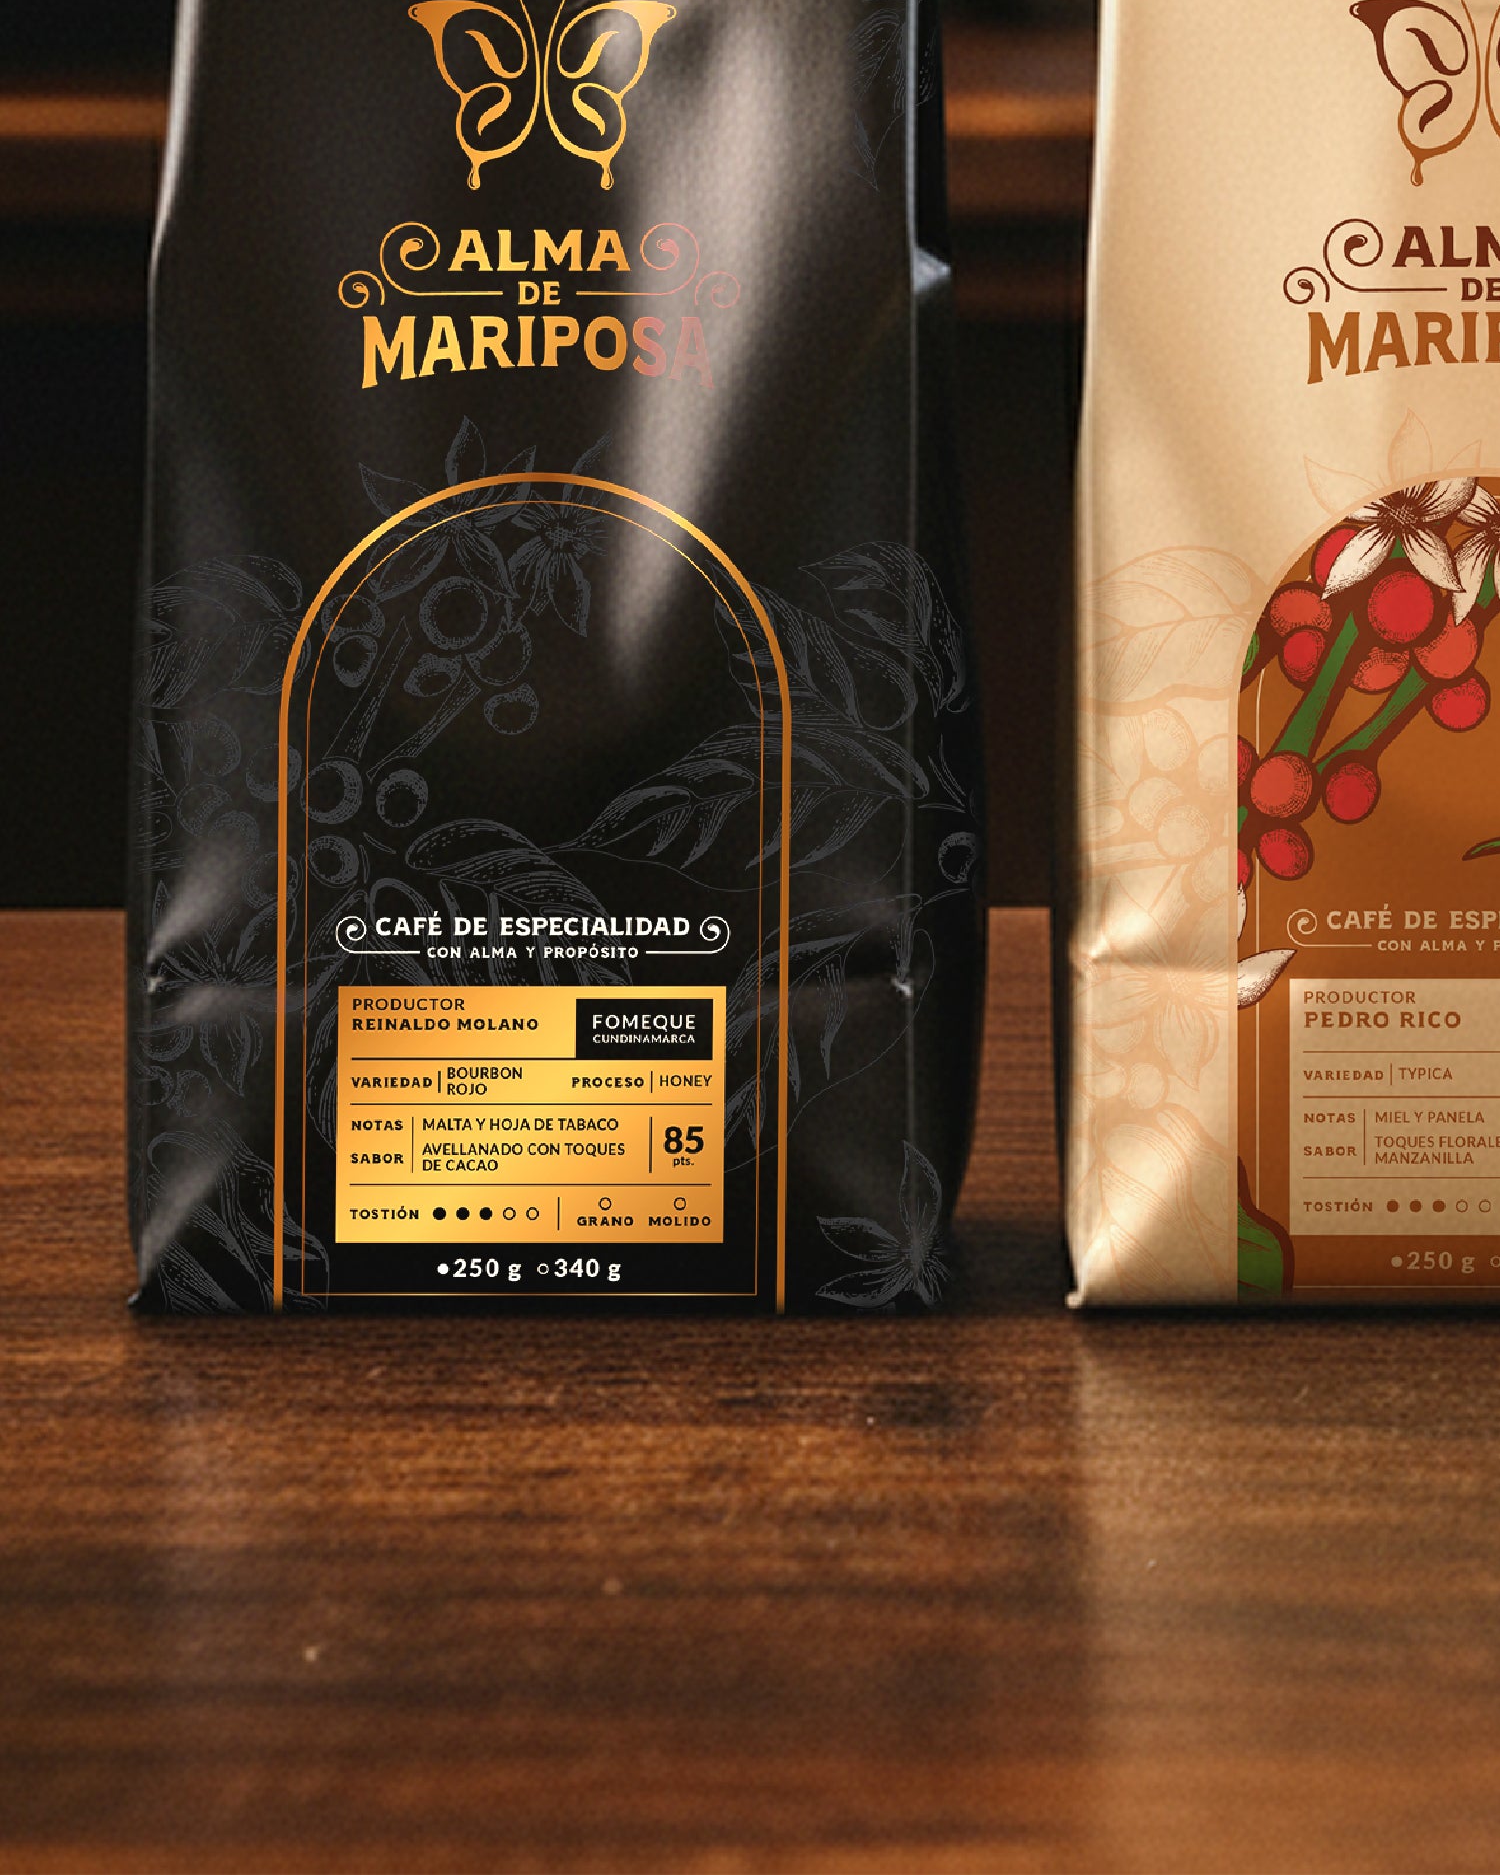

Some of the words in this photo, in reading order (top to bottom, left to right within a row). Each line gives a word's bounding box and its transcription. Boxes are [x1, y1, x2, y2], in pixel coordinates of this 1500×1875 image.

[447, 229, 632, 272] ALMA
[517, 281, 561, 306] DE
[361, 315, 715, 390] MARIPOSA
[375, 910, 442, 937] CAFÉ
[453, 917, 489, 937] DE
[500, 916, 691, 937] ESPECIALIDAD
[1326, 903, 1392, 931] CAFÉ
[1404, 910, 1438, 930] DE
[426, 945, 462, 960] CON
[469, 945, 517, 960] ALMA
[525, 945, 535, 959] Y
[543, 942, 640, 960] PROPÓSITO
[1377, 938, 1412, 953] CON
[1419, 939, 1468, 952] ALMA
[1475, 939, 1486, 952] Y
[352, 998, 466, 1012] PRODUCTOR
[1303, 990, 1416, 1005] PRODUCTOR
[351, 1017, 451, 1031] REINALDO
[456, 1017, 539, 1031] MOLANO
[592, 1014, 697, 1032] FOMEQUE
[1303, 1011, 1390, 1029] PEDRO
[1399, 1011, 1462, 1029] RICO
[592, 1033, 696, 1045] CUNDINAMARCA
[446, 1066, 523, 1081] BOURBON
[659, 1074, 713, 1088] HONEY
[1302, 1069, 1385, 1081] VARIEDAD
[1398, 1067, 1454, 1081] TYPICA
[351, 1076, 433, 1089] VARIEDAD
[446, 1082, 488, 1097] ROJO
[571, 1076, 645, 1089] PROCESO
[422, 1117, 474, 1132] MALTA
[475, 1117, 486, 1132] Y
[489, 1117, 531, 1132] HOJA
[534, 1117, 555, 1132] DE
[558, 1117, 620, 1132] TABACO
[1303, 1112, 1356, 1124] NOTAS
[1375, 1110, 1411, 1124] MIEL
[1413, 1110, 1424, 1124] Y
[1427, 1110, 1485, 1124] PANELA
[351, 1119, 404, 1132] NOTAS
[663, 1126, 705, 1155] 85
[1374, 1135, 1435, 1151] TOQUES
[422, 1142, 524, 1156] AVELLANADO
[526, 1142, 561, 1156] CON
[563, 1142, 626, 1158] TOQUES
[1303, 1145, 1358, 1157] SABOR
[350, 1152, 405, 1165] SABOR
[422, 1158, 443, 1172] DE
[445, 1158, 499, 1173] CACAO
[672, 1155, 695, 1169] pts.
[1375, 1151, 1475, 1165] MANZANILLA
[350, 1204, 419, 1221] TOSTIÓN
[1303, 1197, 1374, 1213] TOSTIÓN
[576, 1216, 634, 1228] GRANO
[648, 1216, 712, 1228] MOLIDO
[452, 1258, 500, 1278] 250
[507, 1261, 522, 1282] g
[553, 1258, 600, 1278] 340
[607, 1261, 622, 1282] g
[1406, 1251, 1454, 1271] 250
[1461, 1254, 1476, 1275] g
